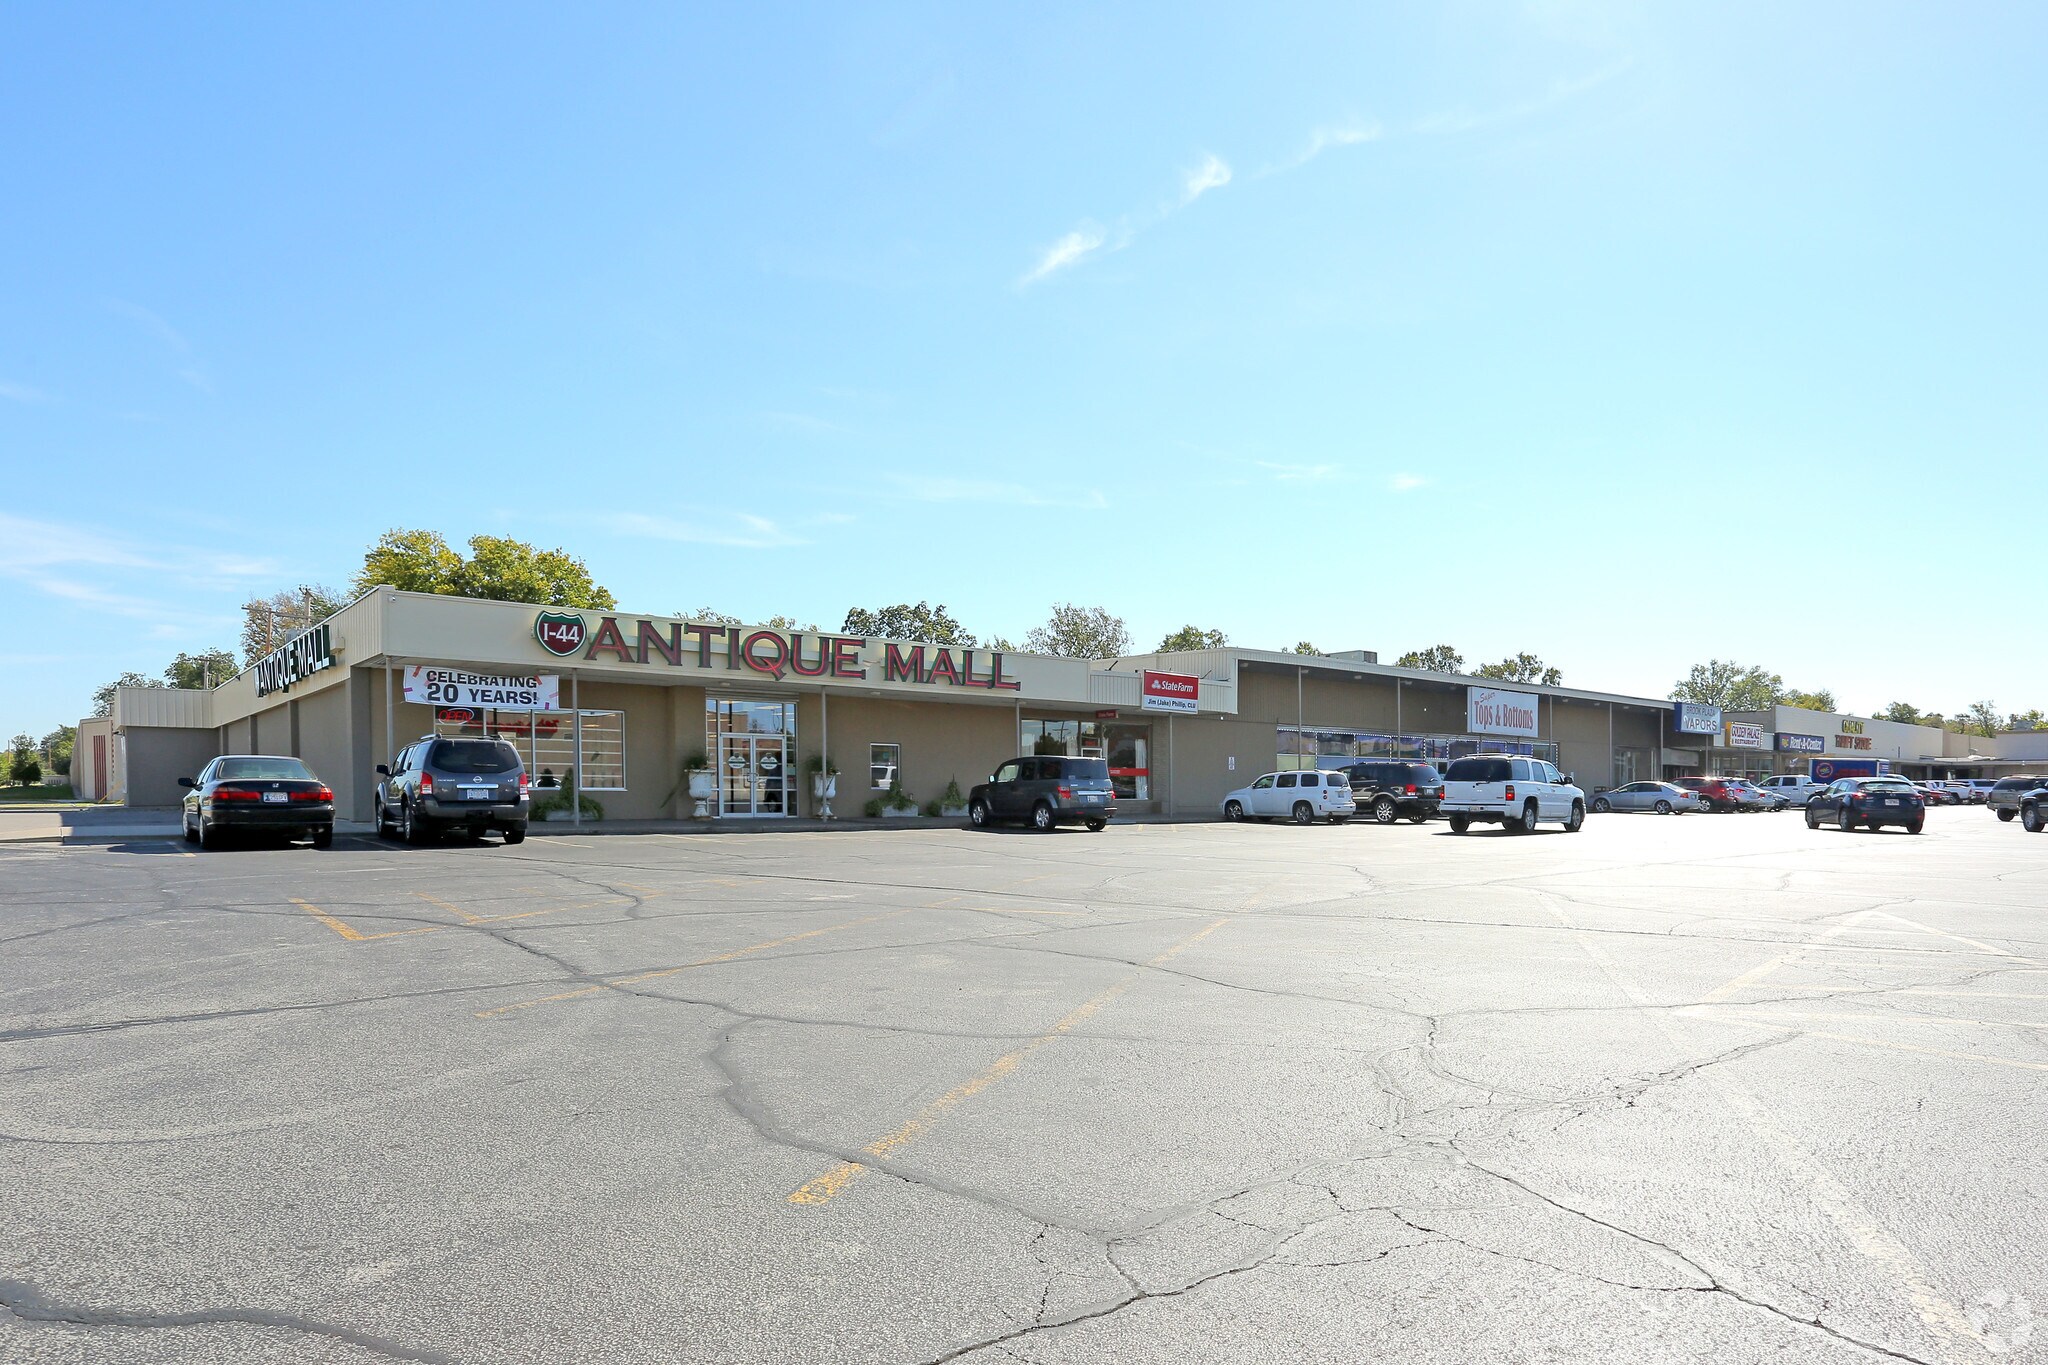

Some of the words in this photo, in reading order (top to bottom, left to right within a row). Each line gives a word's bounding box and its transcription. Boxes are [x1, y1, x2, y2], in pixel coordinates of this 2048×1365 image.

[543, 623, 580, 643] I-44
[258, 643, 297, 692] ANTIQUE
[297, 625, 334, 679] MALL
[583, 617, 867, 681] ANTIQUE
[884, 643, 1021, 691] MALL
[426, 670, 537, 688] CELEBRATING
[1161, 681, 1177, 691] State
[1177, 682, 1194, 692] Farm
[426, 682, 459, 703] 20
[469, 688, 538, 705] YEARS!
[439, 709, 473, 721] OPEN
[1474, 700, 1493, 730] Tops
[1495, 704, 1501, 726] &
[1503, 703, 1534, 730] Bottoms
[1702, 707, 1716, 717] PLAZA
[1684, 717, 1717, 731] VAPORS
